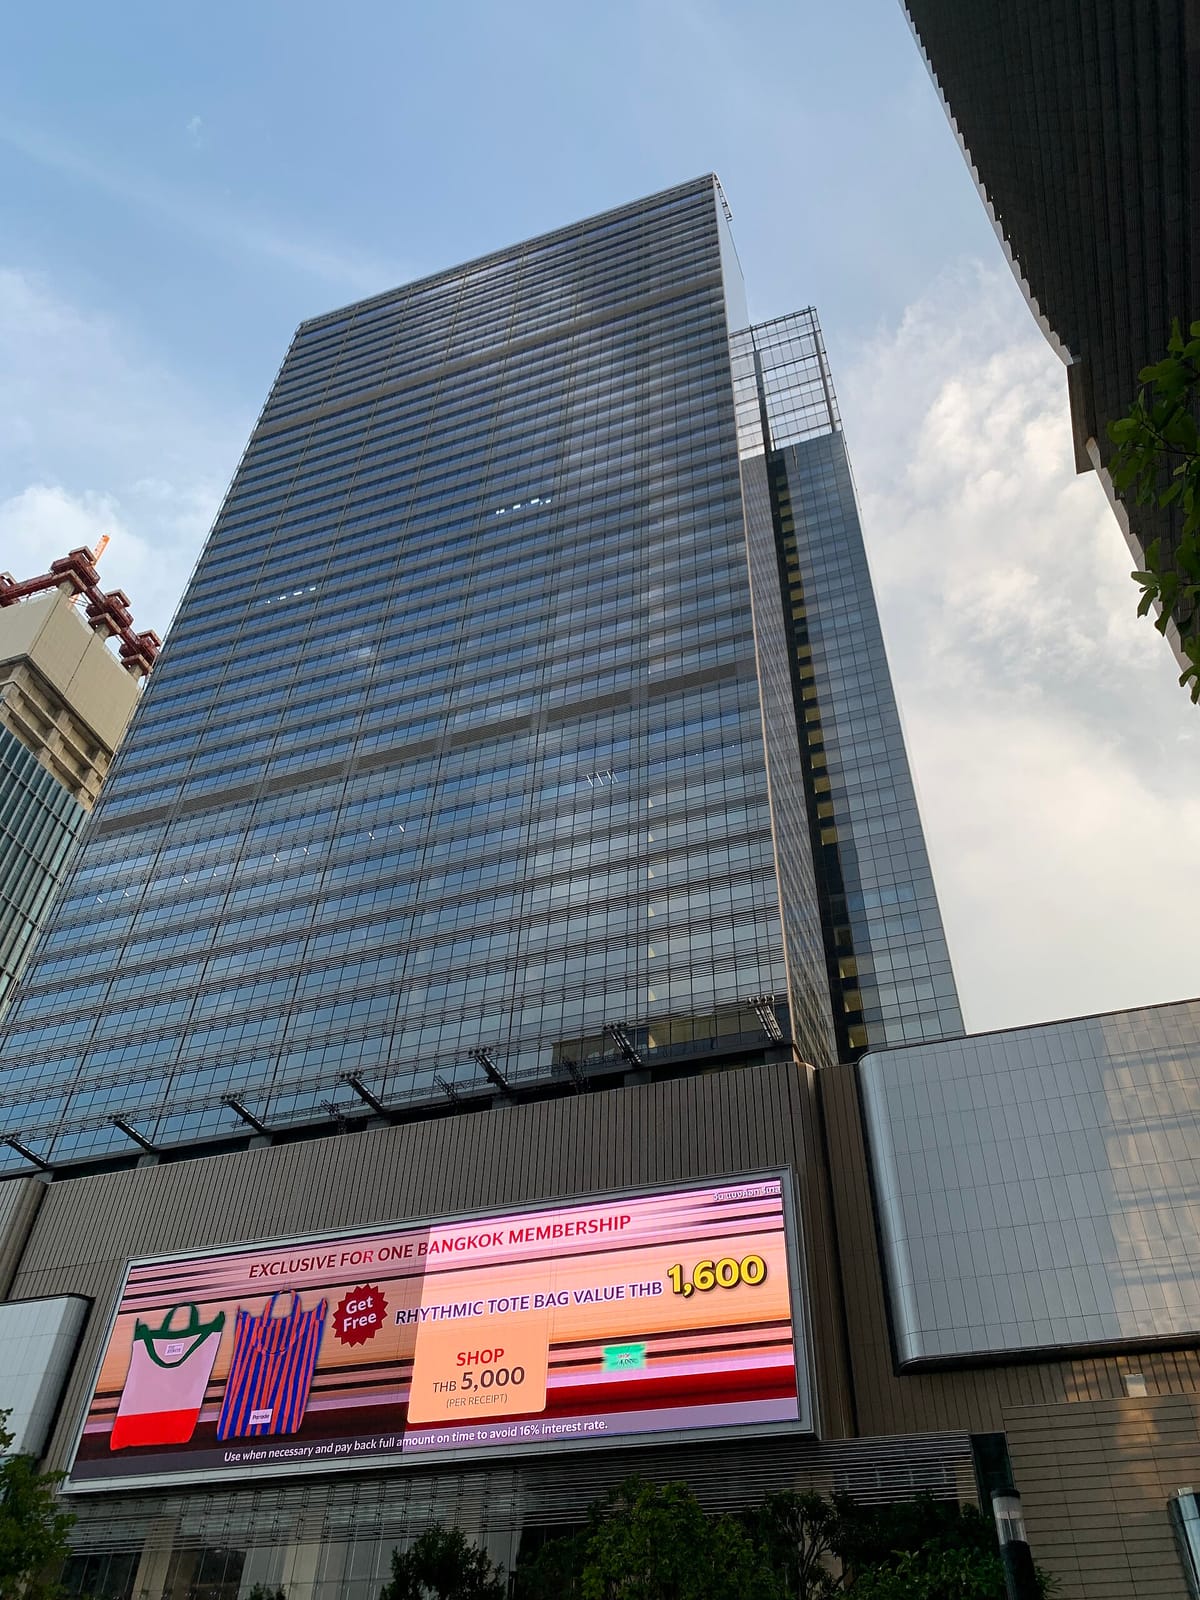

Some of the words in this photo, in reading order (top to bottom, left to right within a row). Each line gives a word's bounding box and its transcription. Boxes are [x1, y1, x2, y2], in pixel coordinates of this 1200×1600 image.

[248, 1254, 337, 1279] EXCLUSIVE
[340, 1250, 374, 1267] FOR
[377, 1244, 414, 1262] ONE
[417, 1232, 504, 1257] BANGKOK
[508, 1215, 631, 1245] MEMBERSHIP
[395, 1301, 484, 1325] RHYTHMIC
[487, 1295, 530, 1314] TOTE
[533, 1291, 570, 1309] BAG
[573, 1285, 626, 1304] VALUE
[628, 1281, 663, 1298] THB
[667, 1254, 768, 1298] 1,600
[345, 1295, 374, 1314] Get
[343, 1312, 377, 1333] Free
[456, 1348, 505, 1367] SHOP
[432, 1380, 457, 1393] THB
[460, 1366, 525, 1392] 5,000
[446, 1397, 467, 1408] (PER
[468, 1393, 508, 1406] RECEIPT)
[224, 1452, 241, 1463] Use
[242, 1449, 267, 1460] when
[268, 1445, 313, 1459] necessary
[314, 1443, 334, 1454] and
[334, 1441, 353, 1455] pay
[354, 1438, 378, 1450] back
[378, 1437, 395, 1449] full
[396, 1432, 435, 1446] amount
[437, 1434, 450, 1443] on
[451, 1431, 475, 1442] time
[477, 1430, 488, 1440] to
[489, 1426, 518, 1439] avoid
[519, 1424, 540, 1436] 16%
[541, 1421, 582, 1434] interest
[583, 1420, 609, 1431] rate.
